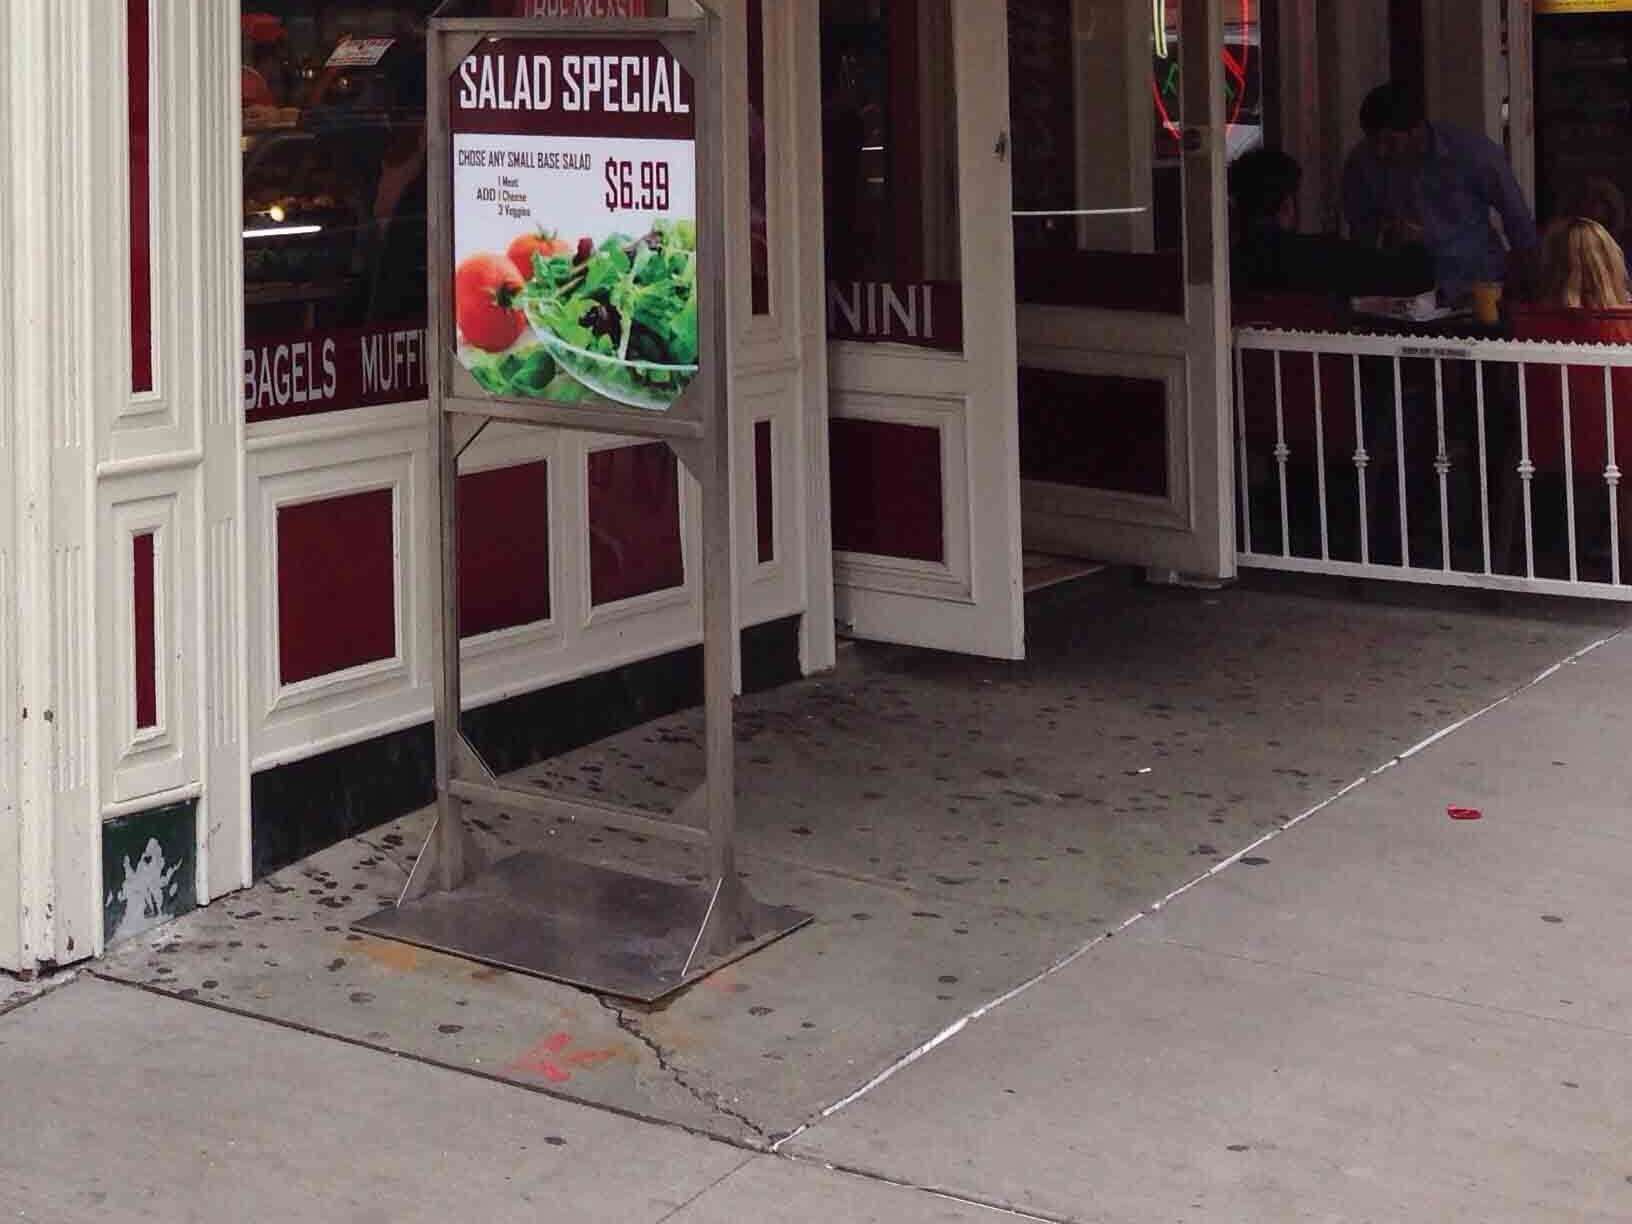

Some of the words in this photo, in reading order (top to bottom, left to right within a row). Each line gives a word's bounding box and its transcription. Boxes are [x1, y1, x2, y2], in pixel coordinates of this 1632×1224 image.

[460, 55, 553, 110] SALAD
[562, 55, 690, 113] SPECIAL
[487, 151, 506, 168] ANY
[507, 152, 535, 169] SMALL
[537, 152, 560, 170] BASE
[562, 153, 592, 171] SALAD
[604, 156, 670, 212] $6.99
[476, 187, 496, 201] ADD
[242, 337, 337, 410] BAGELS
[360, 327, 429, 394] MUFFI
